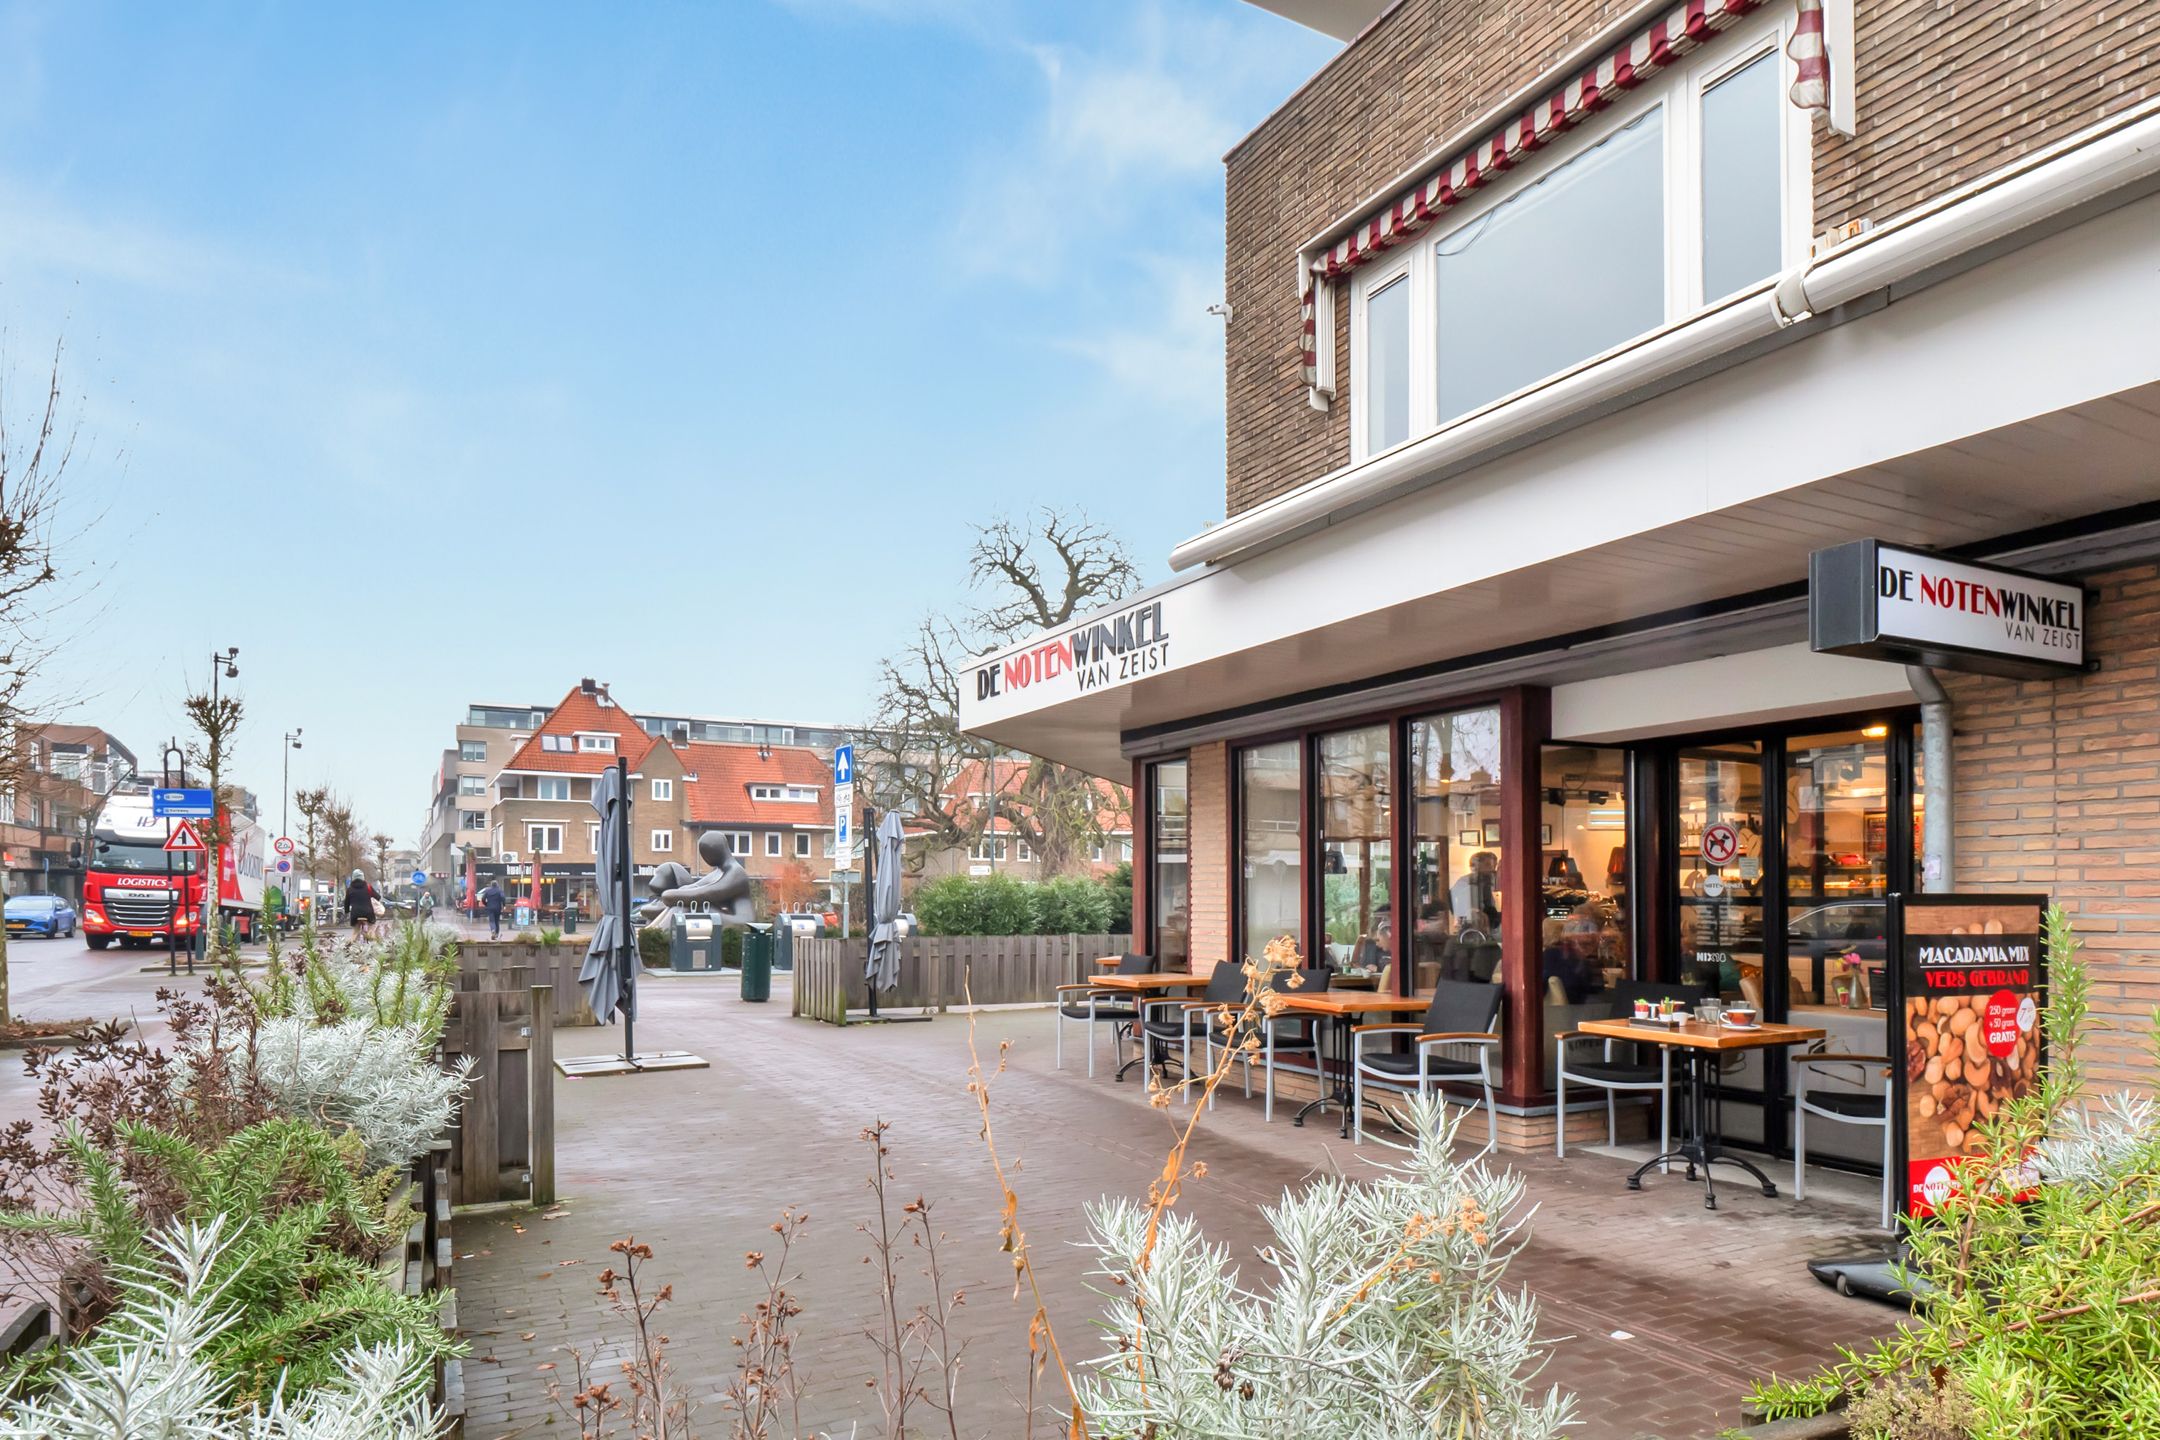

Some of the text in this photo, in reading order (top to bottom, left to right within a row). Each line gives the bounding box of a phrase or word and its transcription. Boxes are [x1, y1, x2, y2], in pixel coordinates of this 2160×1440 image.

[1880, 566, 1913, 601] DE
[2005, 621, 2080, 650] VAN ZEIST
[1077, 643, 1169, 692] VAN ZEIST
[977, 663, 1001, 701] DE
[117, 877, 168, 887] LOGISTICS
[1919, 946, 2030, 964] MACADAMIA MIX
[1925, 969, 2029, 988] VERS GEBRAND
[1989, 1030, 2016, 1043] GRATIS
